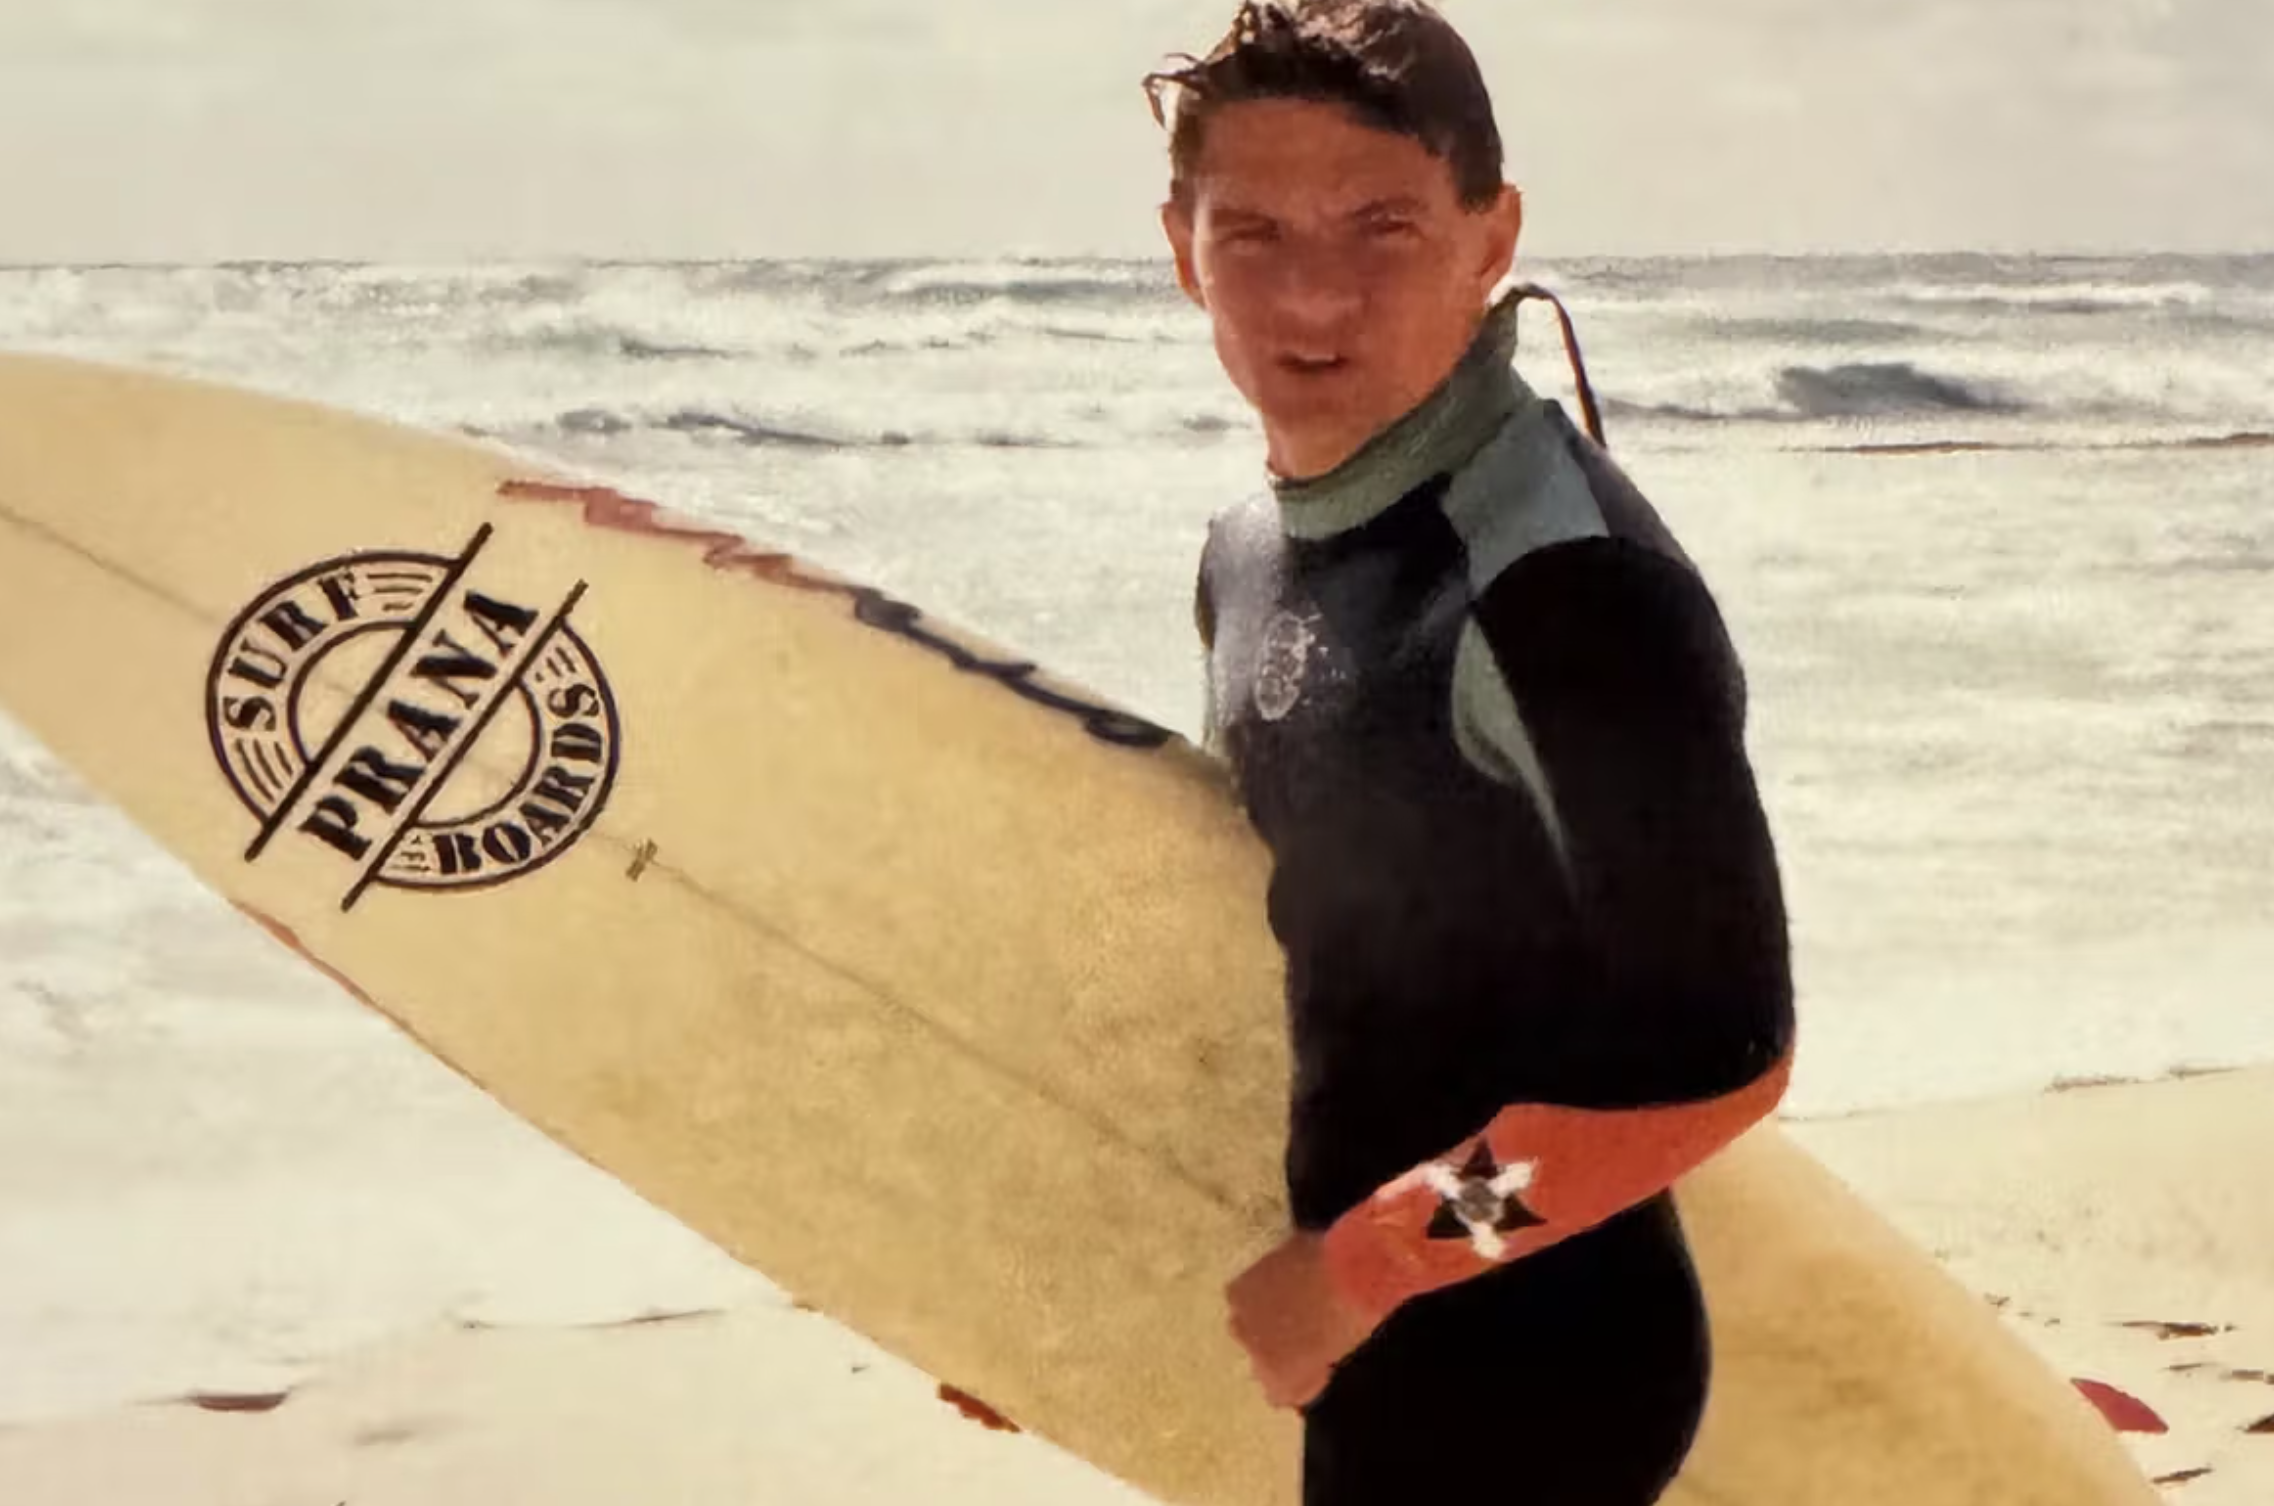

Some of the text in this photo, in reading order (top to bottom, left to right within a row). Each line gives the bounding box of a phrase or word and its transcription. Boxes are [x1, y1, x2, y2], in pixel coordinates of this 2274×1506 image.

[223, 568, 361, 732] SURF
[297, 591, 538, 860] PRANA
[433, 683, 604, 875] BOARDS
